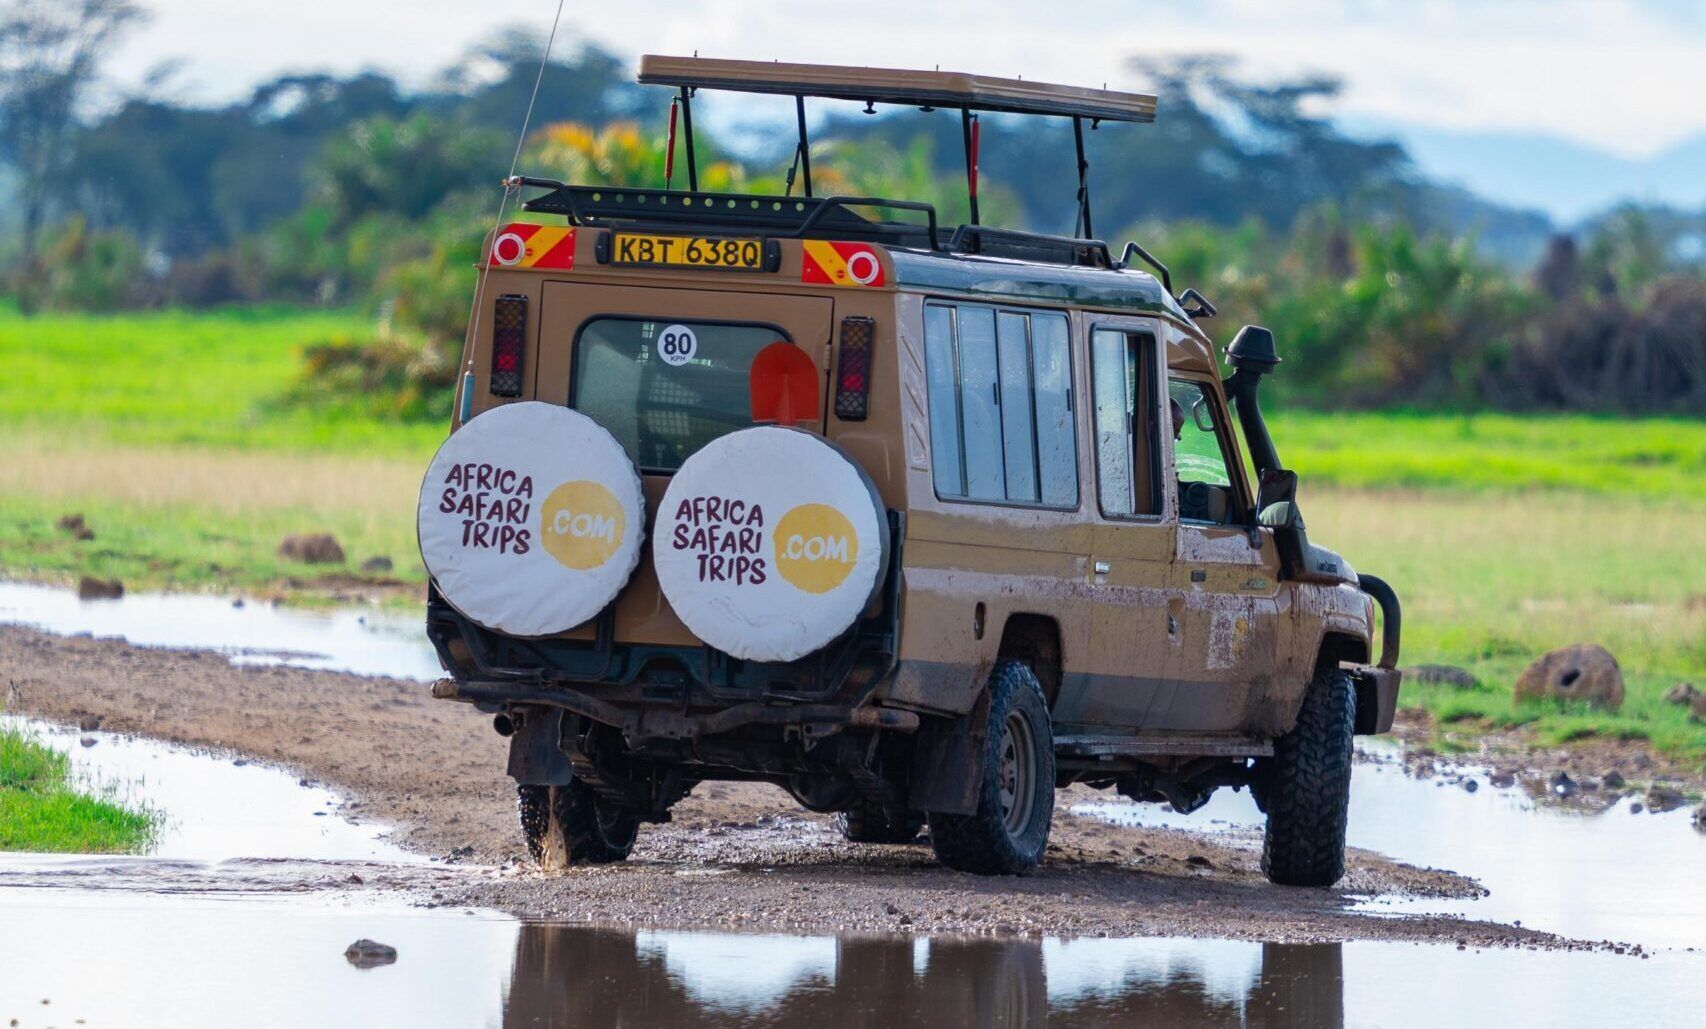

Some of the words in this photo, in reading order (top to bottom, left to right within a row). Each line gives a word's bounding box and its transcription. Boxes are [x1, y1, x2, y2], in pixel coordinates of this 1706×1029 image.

[620, 237, 674, 263] KBT
[664, 332, 692, 355] 80
[444, 463, 533, 499] AFRICA
[439, 488, 530, 525] SAFARI
[675, 496, 764, 527] AFRICA
[462, 519, 531, 554] TRIPS
[673, 523, 762, 554] SAFARI
[697, 554, 766, 585] TRIPS
